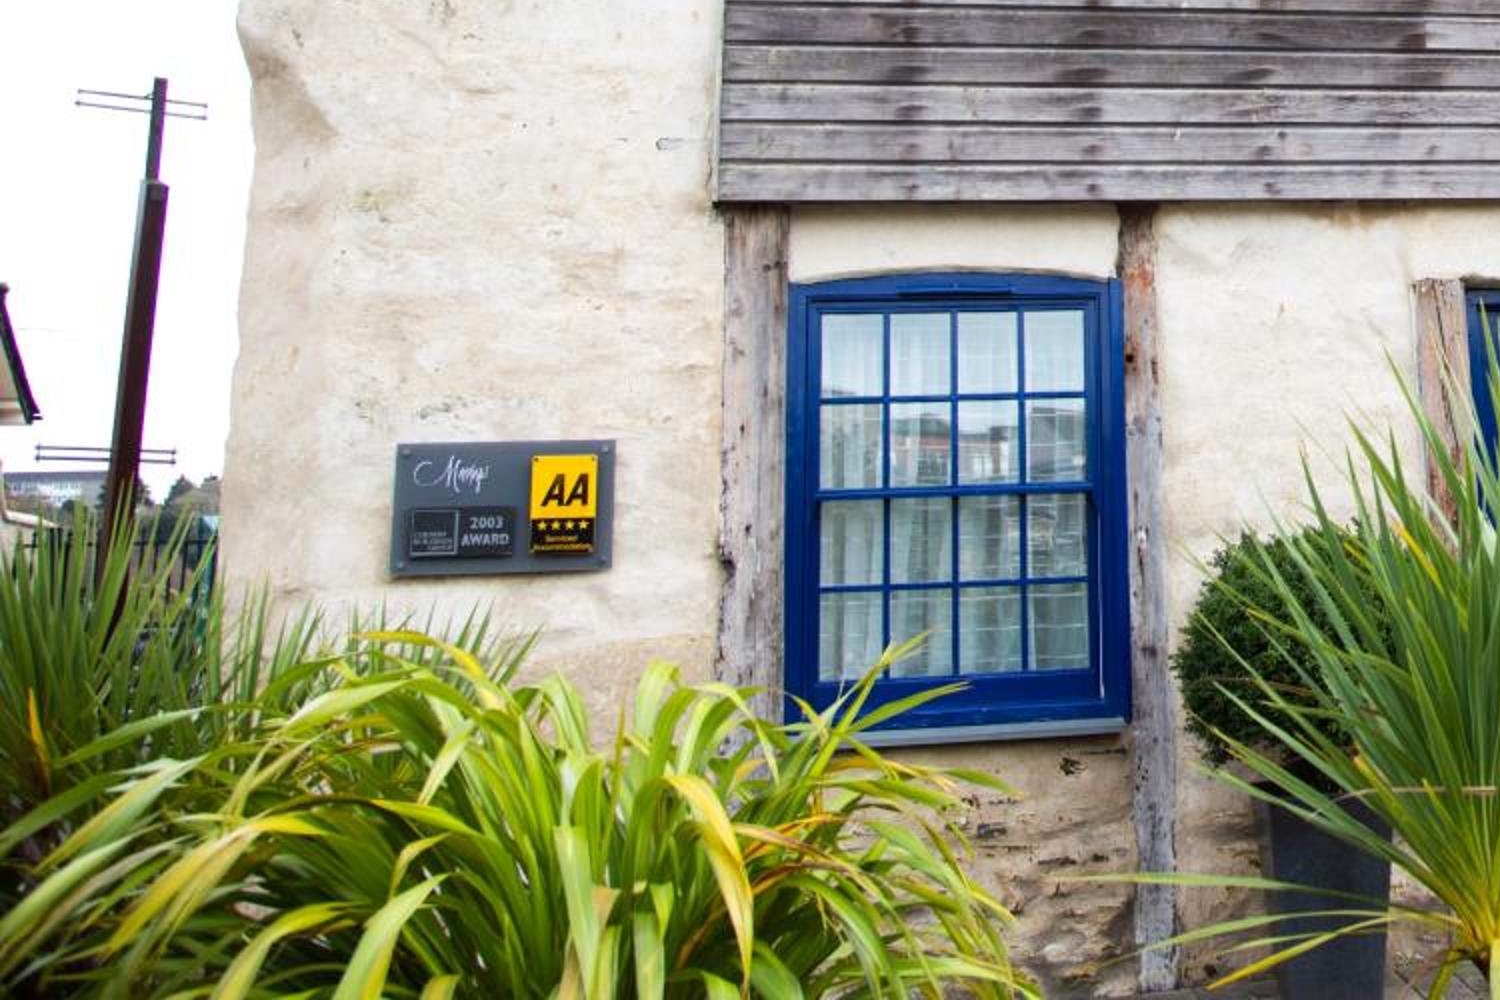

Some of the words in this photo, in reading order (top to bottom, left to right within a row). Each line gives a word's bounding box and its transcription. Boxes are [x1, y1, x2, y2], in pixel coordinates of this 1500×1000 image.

[541, 473, 588, 506] AA
[469, 516, 504, 529] 2003
[461, 533, 510, 547] AWARD
